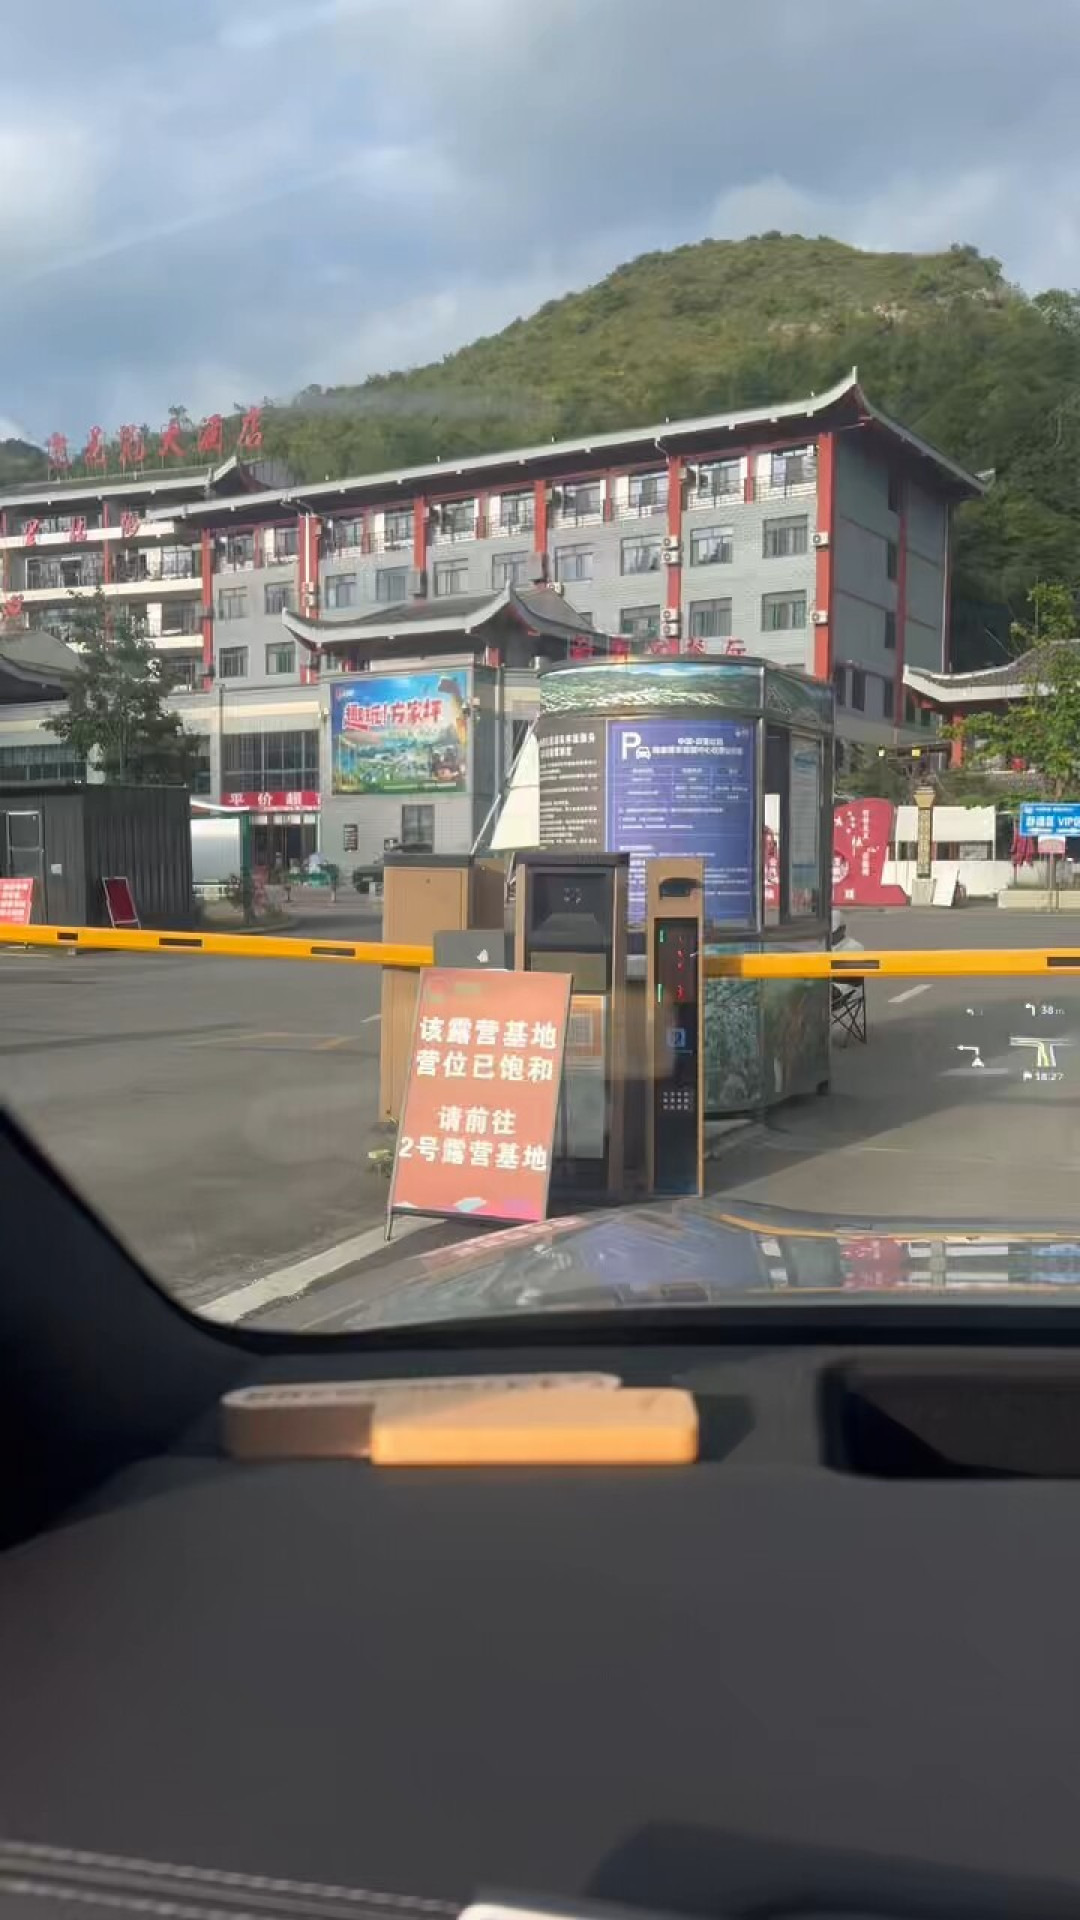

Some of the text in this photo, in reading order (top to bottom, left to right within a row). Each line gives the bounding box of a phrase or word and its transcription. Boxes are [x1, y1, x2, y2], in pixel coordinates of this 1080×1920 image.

[622, 732, 642, 760] P
[420, 1017, 556, 1049] 该露营基地
[416, 1049, 553, 1083] 营位已饱和
[437, 1105, 516, 1135] 请前往
[399, 1135, 547, 1171] 2号露营基地
